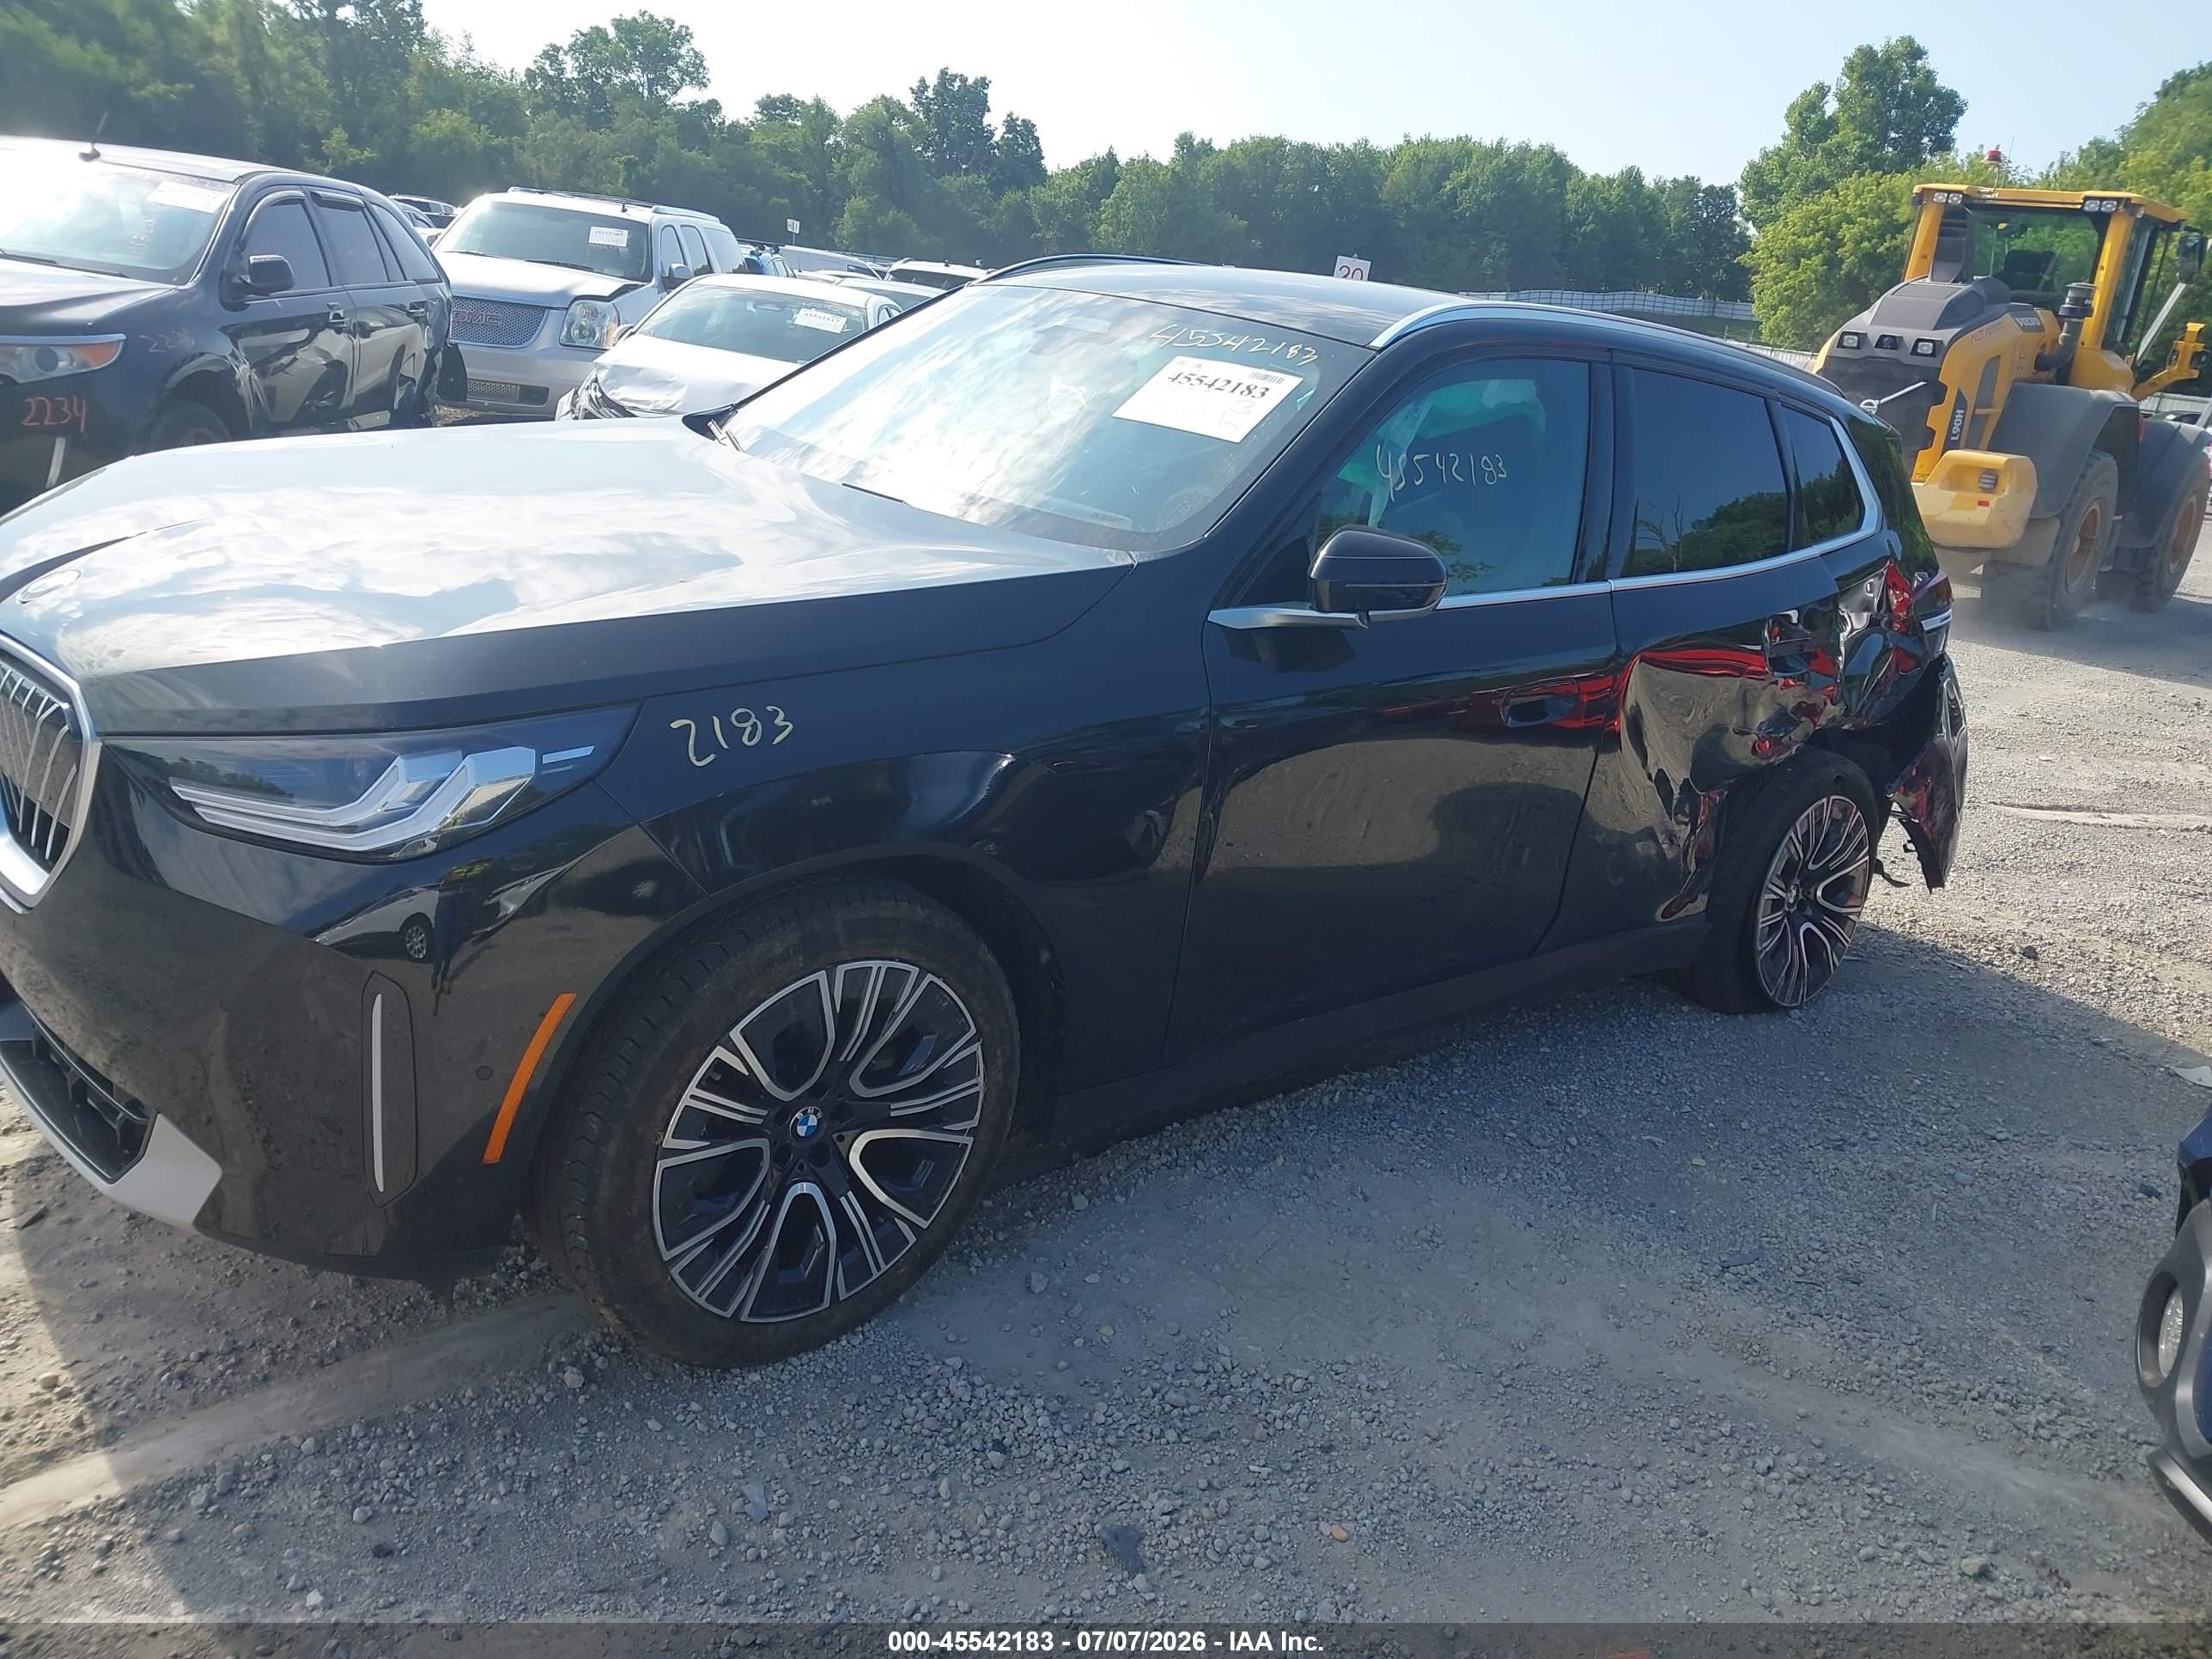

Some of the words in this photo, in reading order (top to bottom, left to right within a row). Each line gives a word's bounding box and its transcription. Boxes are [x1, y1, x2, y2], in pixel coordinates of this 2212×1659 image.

[1339, 264, 1364, 281] 20
[452, 309, 501, 326] GMC
[1167, 371, 1270, 399] 45542183
[21, 395, 87, 434] 2234
[1950, 409, 1966, 441] L90H
[1376, 443, 1508, 502] 45542183
[669, 705, 794, 768] 2183
